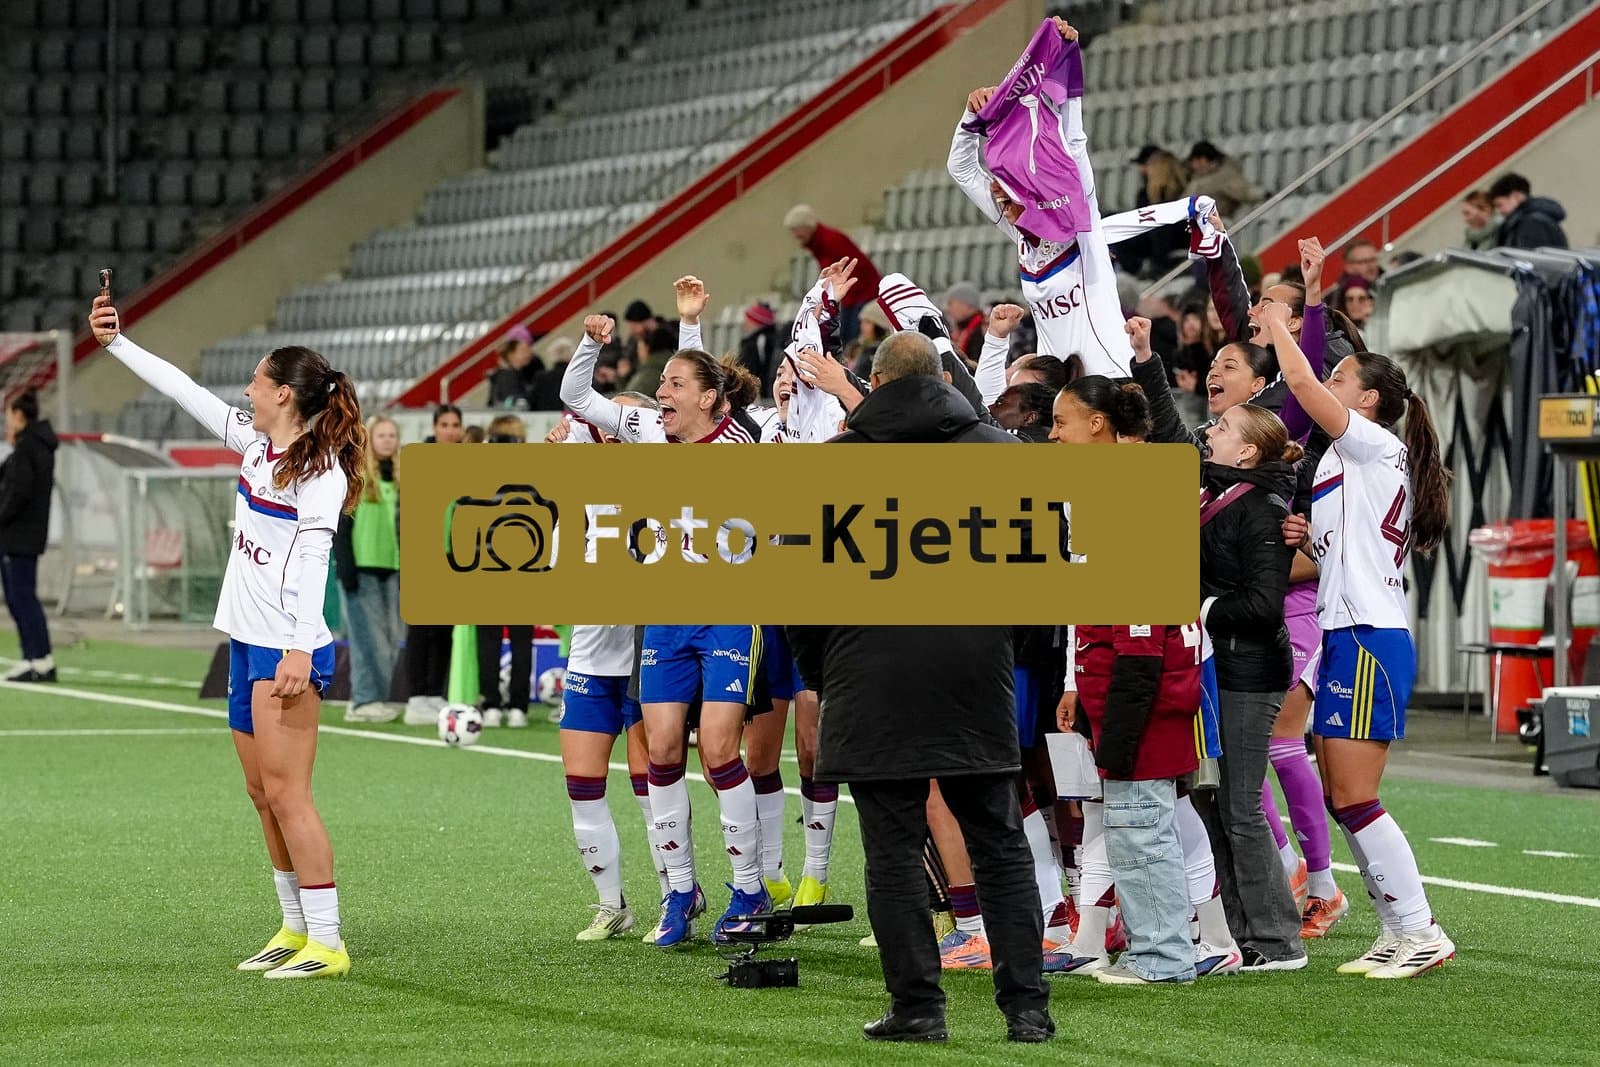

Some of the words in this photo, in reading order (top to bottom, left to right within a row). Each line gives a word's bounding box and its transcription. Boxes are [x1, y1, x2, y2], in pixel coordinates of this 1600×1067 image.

[1035, 283, 1081, 320] MSC
[655, 821, 677, 831] SFC
[721, 825, 738, 833] FC
[580, 846, 598, 855] FC
